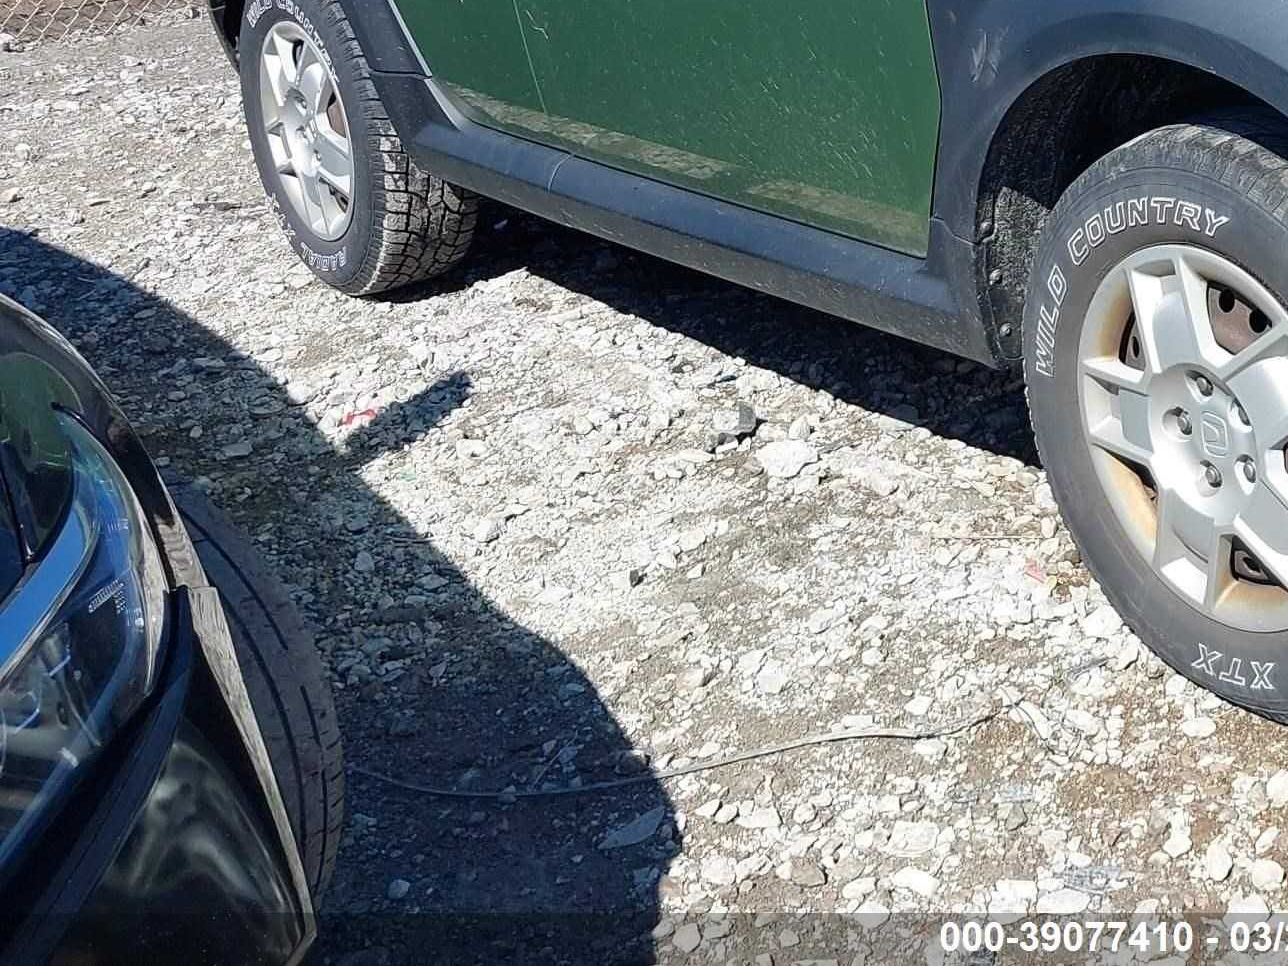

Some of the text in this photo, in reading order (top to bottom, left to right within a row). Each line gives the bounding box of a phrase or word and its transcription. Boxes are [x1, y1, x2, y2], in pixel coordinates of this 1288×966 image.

[1035, 196, 1230, 378] WILD COUNTRY
[1191, 642, 1276, 690] XTX
